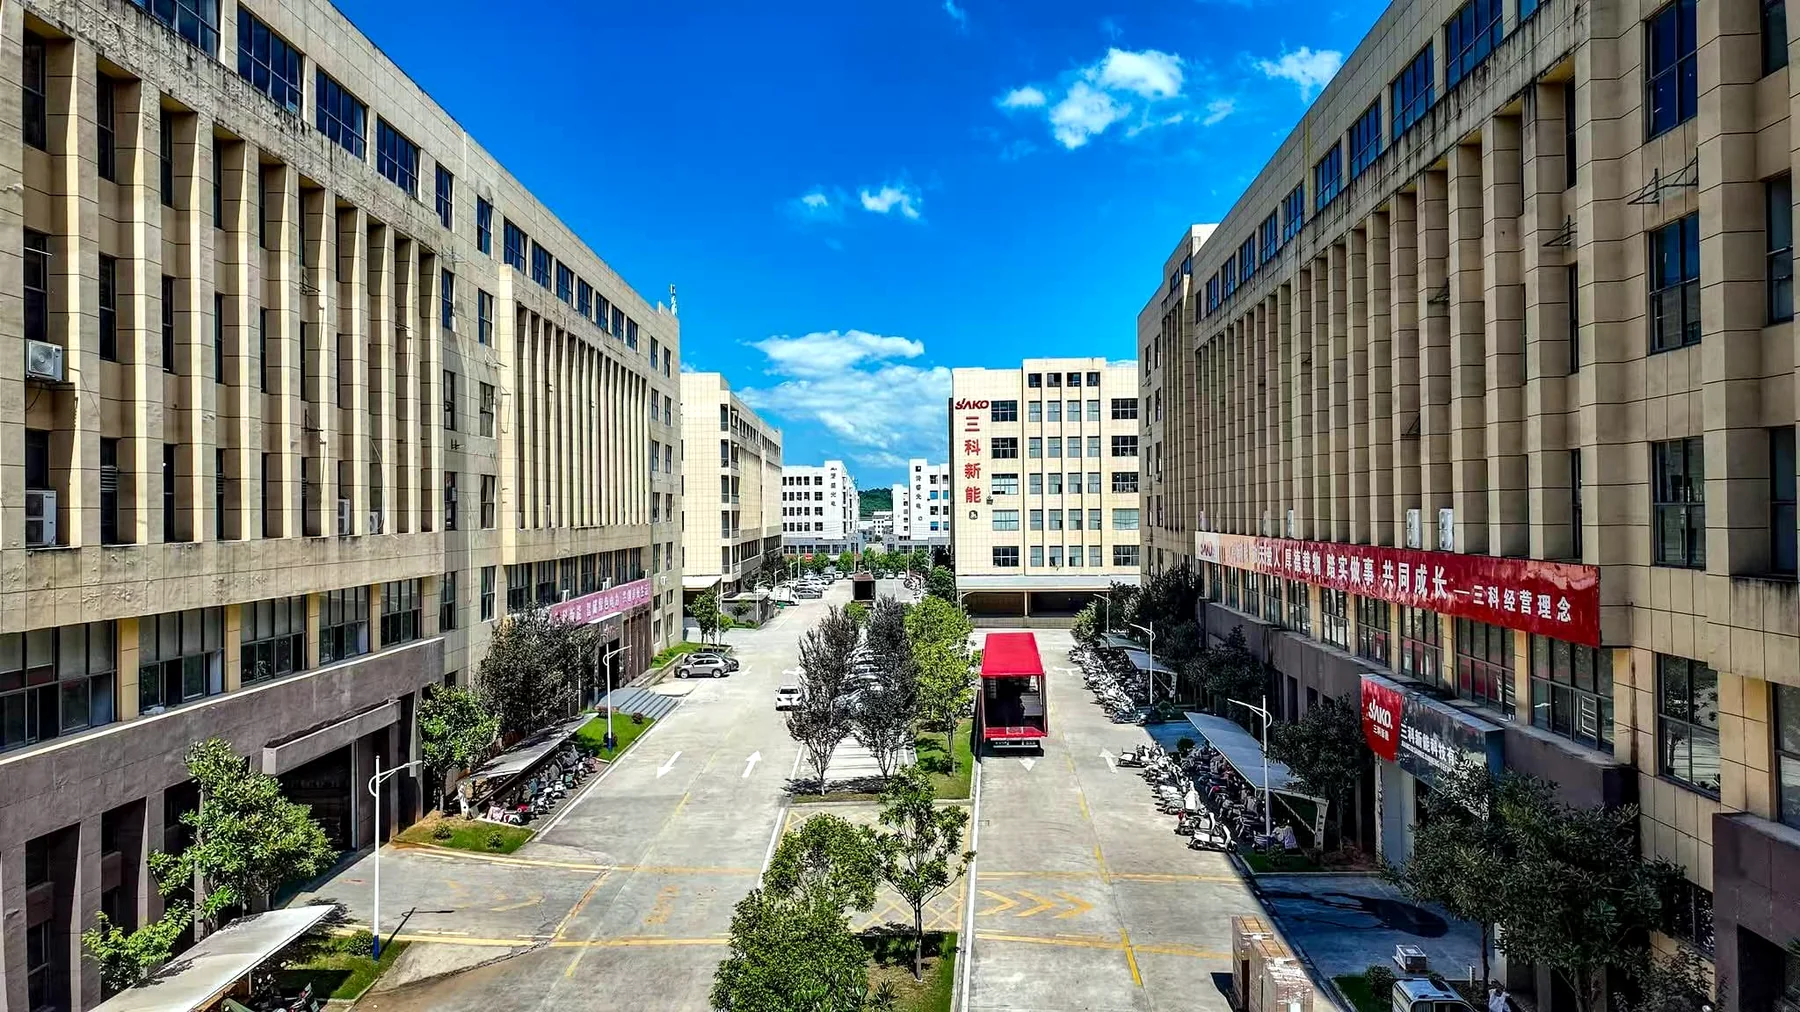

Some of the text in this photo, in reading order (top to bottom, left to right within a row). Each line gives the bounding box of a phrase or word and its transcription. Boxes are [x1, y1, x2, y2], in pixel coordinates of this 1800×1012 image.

[955, 398, 989, 410] SAKO
[964, 416, 981, 503] 三科新能
[1285, 548, 1321, 576] 厚德载物
[1326, 553, 1375, 586] 踏实做事
[1383, 559, 1448, 600] 共同成长
[1368, 698, 1391, 728] SAKO
[1400, 722, 1459, 767] 三科新能科技有
